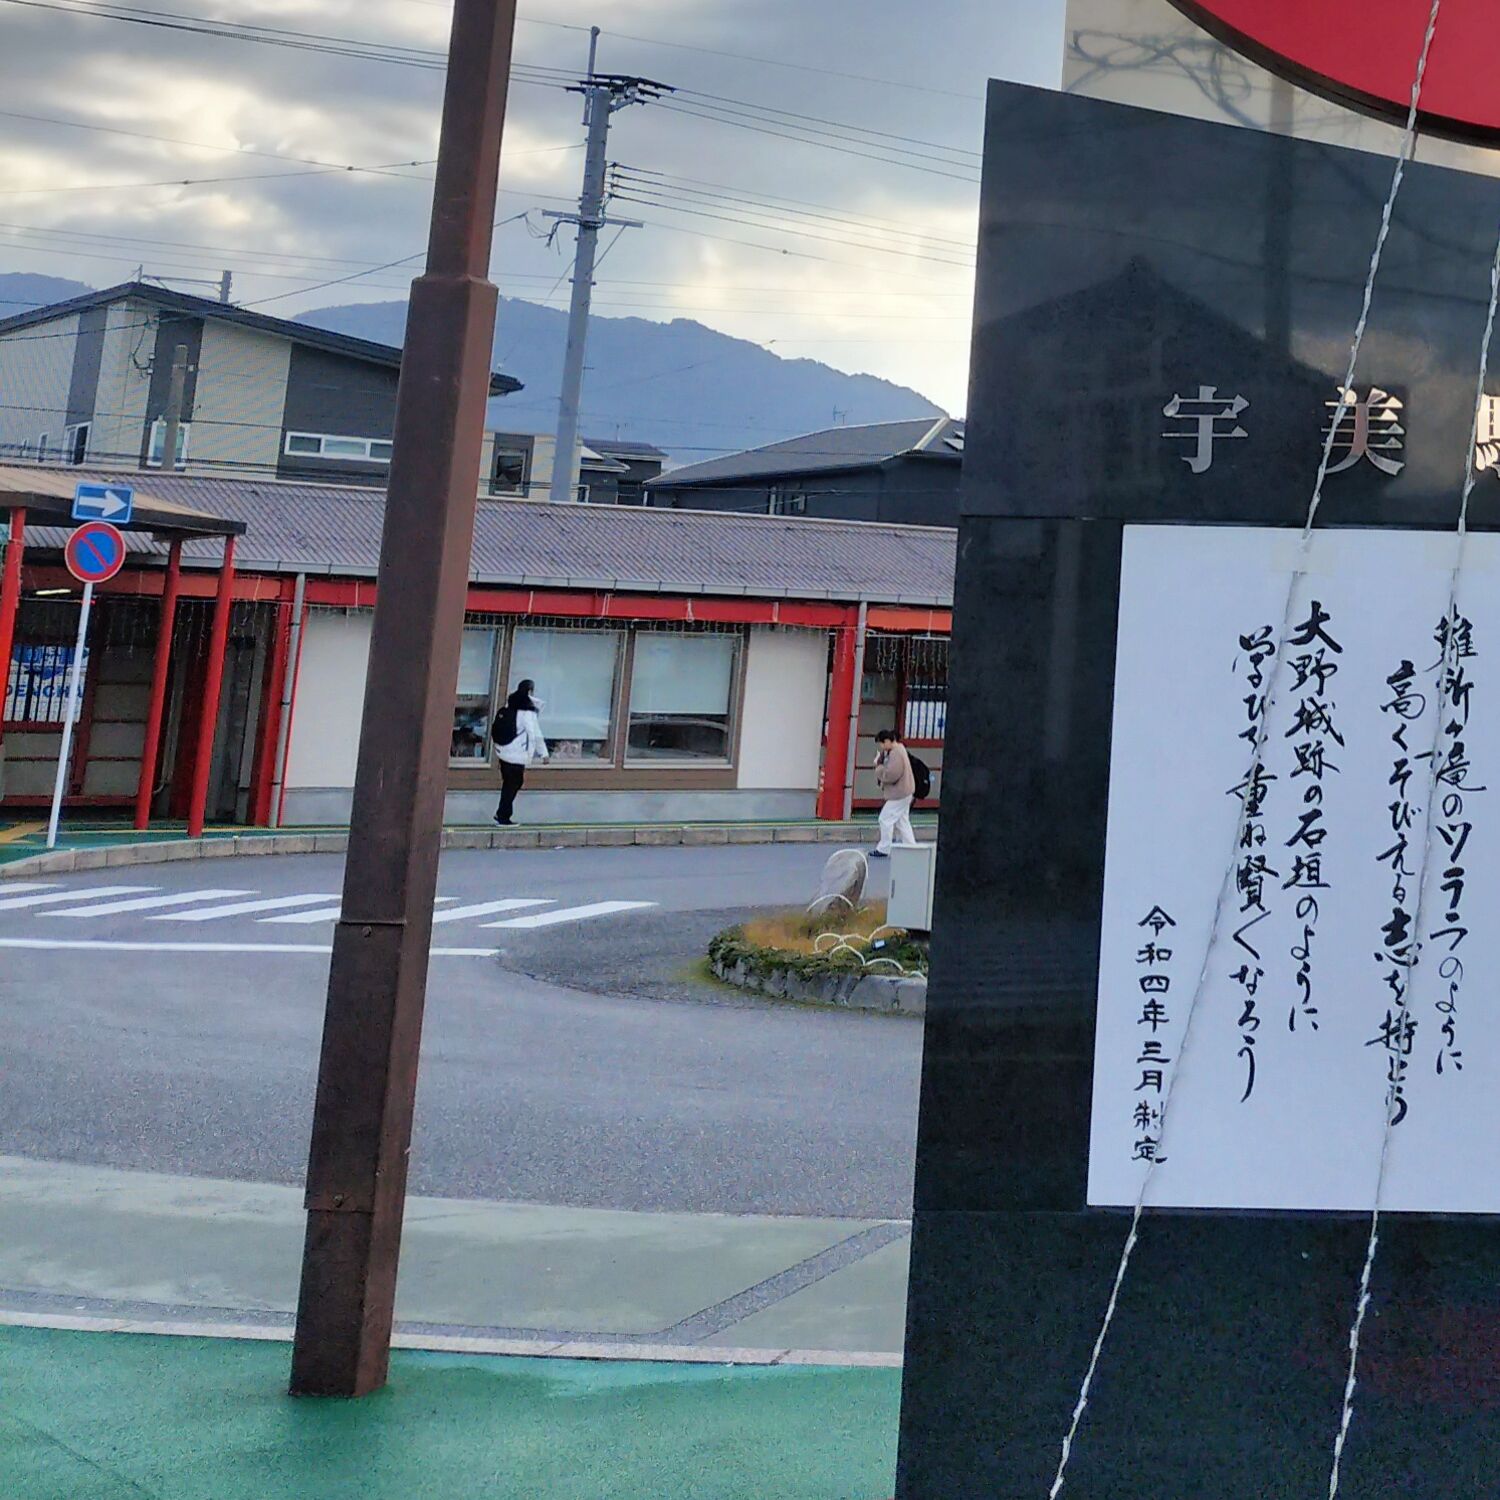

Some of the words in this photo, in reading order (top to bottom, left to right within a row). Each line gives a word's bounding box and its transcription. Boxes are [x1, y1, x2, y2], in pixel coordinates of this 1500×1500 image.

[1282, 600, 1345, 1032] 大野城跡の石垣のように
[1131, 905, 1177, 1164] 令和四年三月制定
